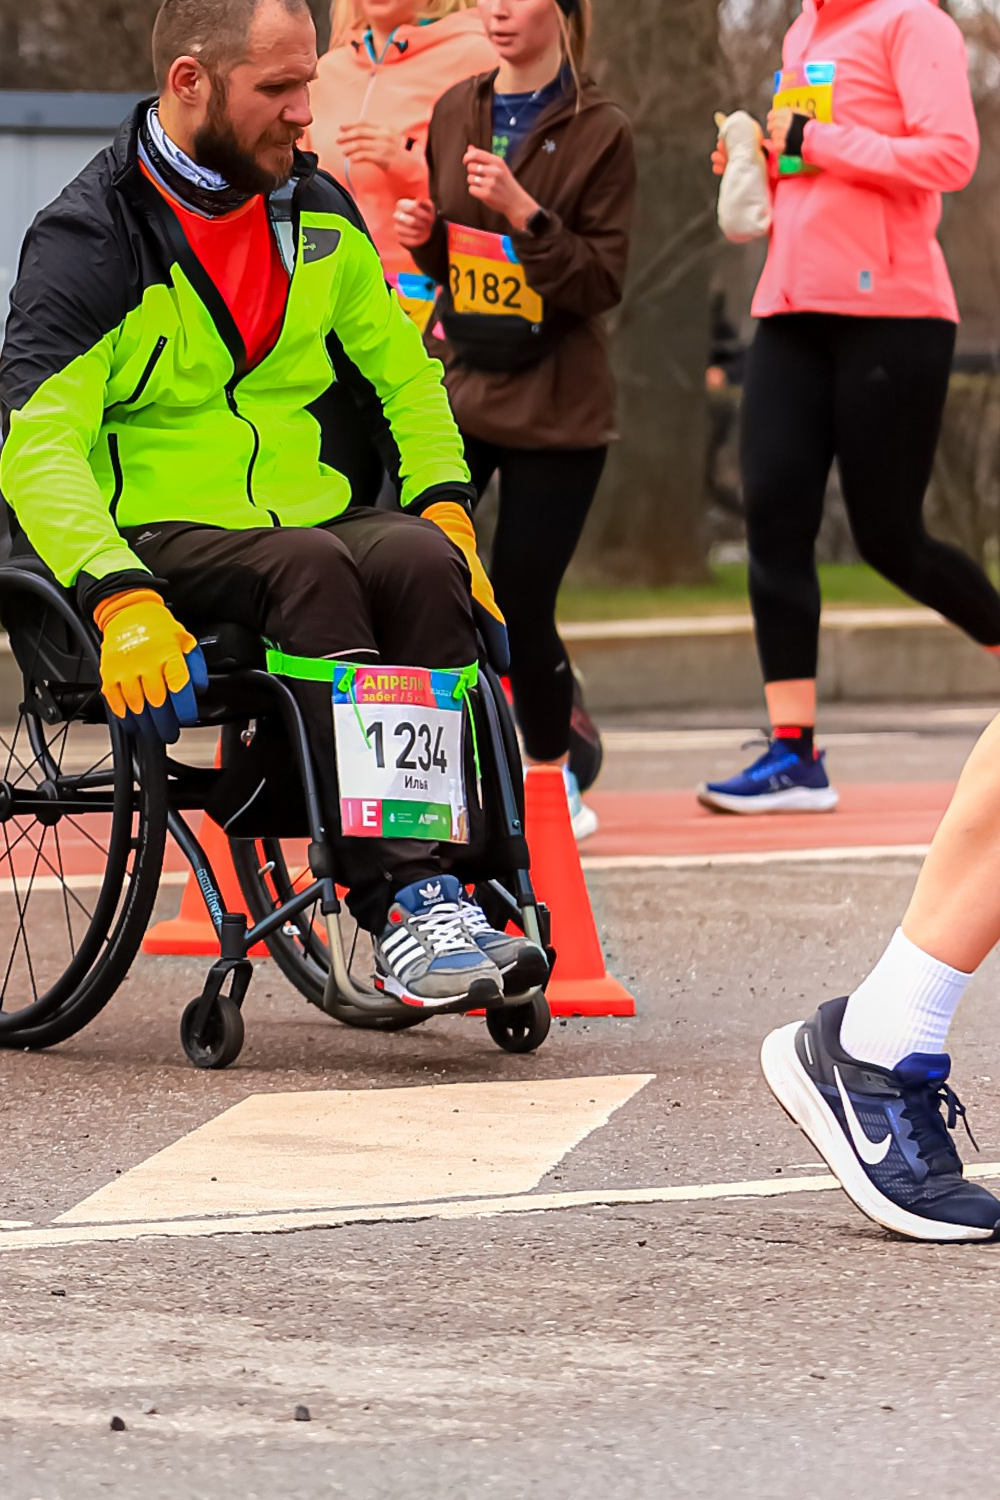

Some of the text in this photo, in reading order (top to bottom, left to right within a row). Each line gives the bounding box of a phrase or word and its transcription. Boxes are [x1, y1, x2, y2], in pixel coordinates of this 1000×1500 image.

[362, 675, 423, 691] АПРЕЛЬ
[362, 691, 398, 702] забег
[366, 721, 447, 774] 1234
[404, 775, 428, 791] Илья
[196, 868, 223, 925] panthera
[423, 893, 445, 906] adidas
